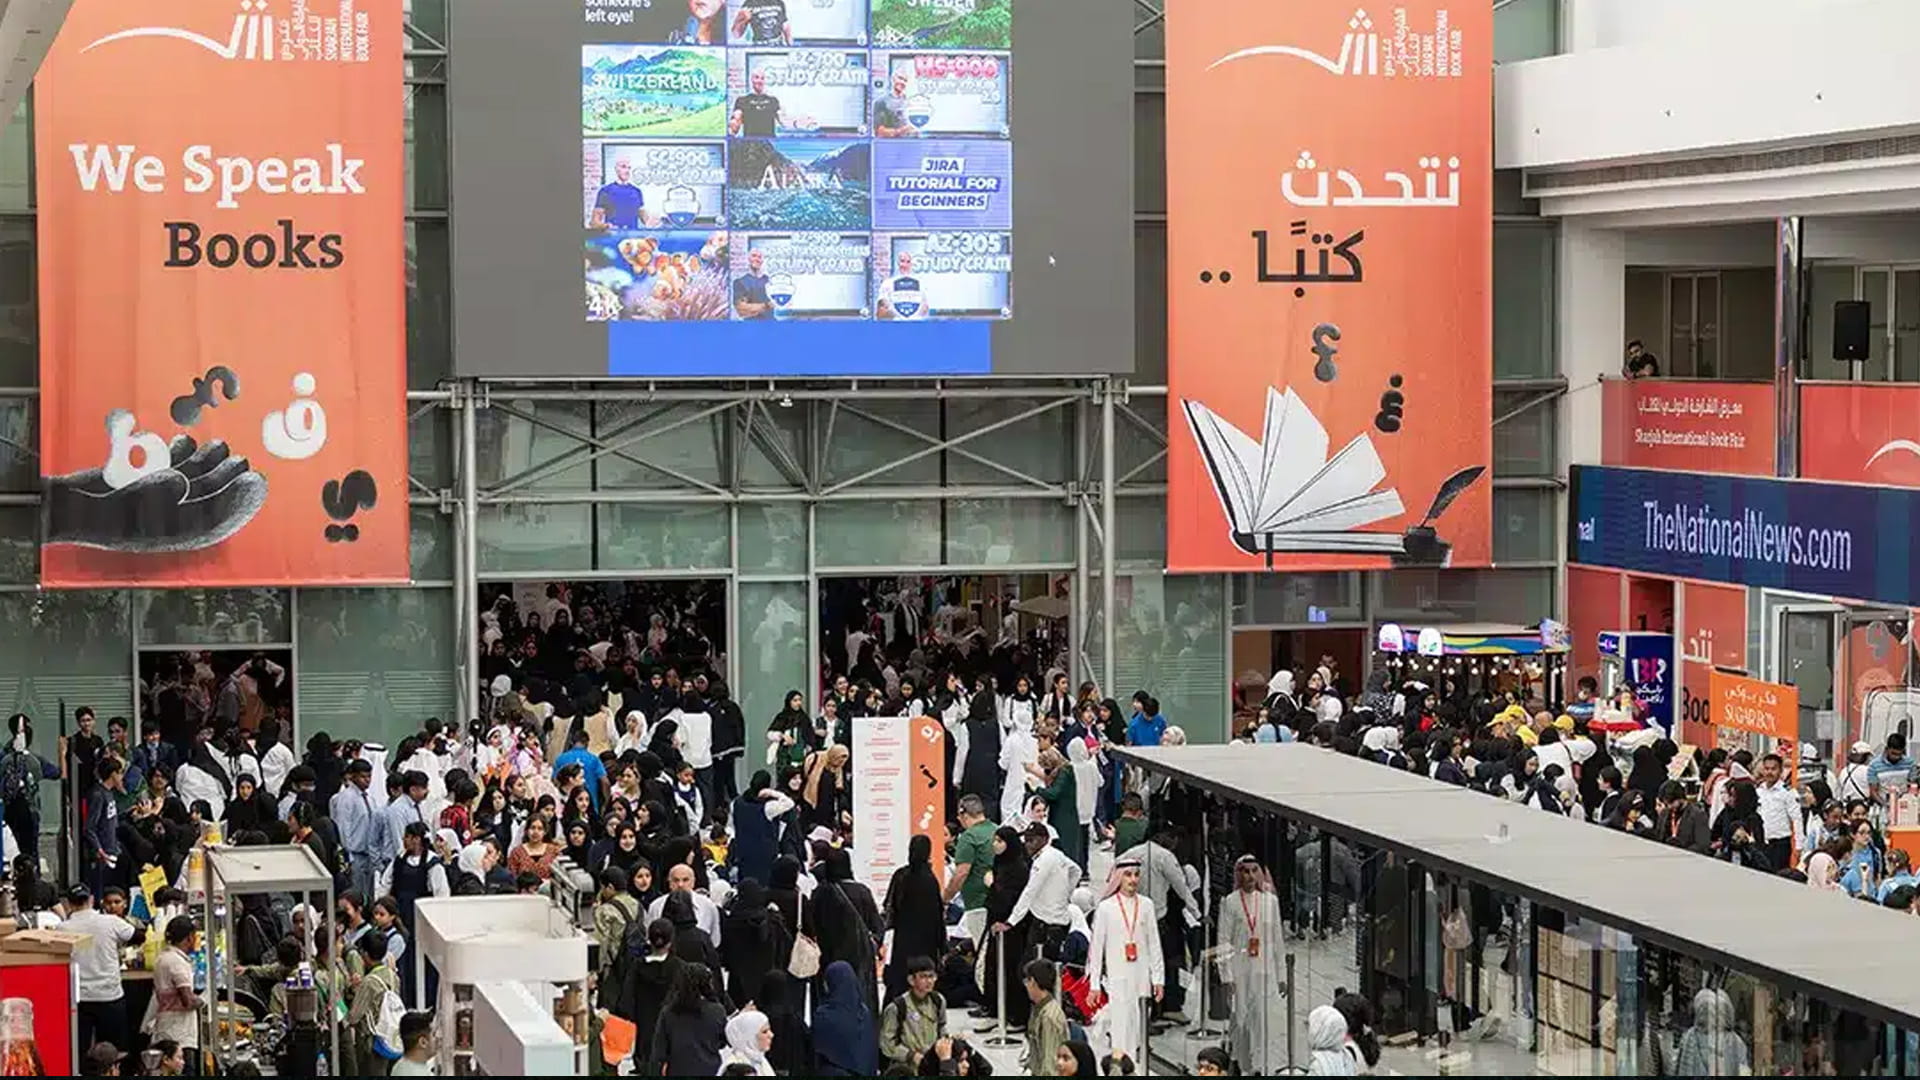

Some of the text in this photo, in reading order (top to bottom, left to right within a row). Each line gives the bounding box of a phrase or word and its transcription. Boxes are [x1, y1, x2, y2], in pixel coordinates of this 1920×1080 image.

[585, 10, 634, 25] left eye!
[765, 67, 868, 86] STUDY CRAM
[914, 55, 999, 78] MS-900
[591, 72, 720, 90] SWITZERLAND
[647, 148, 711, 168] SC-900
[925, 159, 960, 172] JIRA
[69, 143, 365, 208] We Speak
[889, 176, 997, 190] TUTORIAL FOR
[1281, 151, 1460, 206] نتحدث
[900, 195, 985, 207] BEGINNERS
[164, 220, 343, 269] Books
[925, 232, 1001, 254] AZ-305
[912, 255, 1011, 273] STUDY CRAM
[1635, 428, 1745, 448] Sharjah International Book Fair
[1644, 500, 1852, 572] TheNationalNews.com
